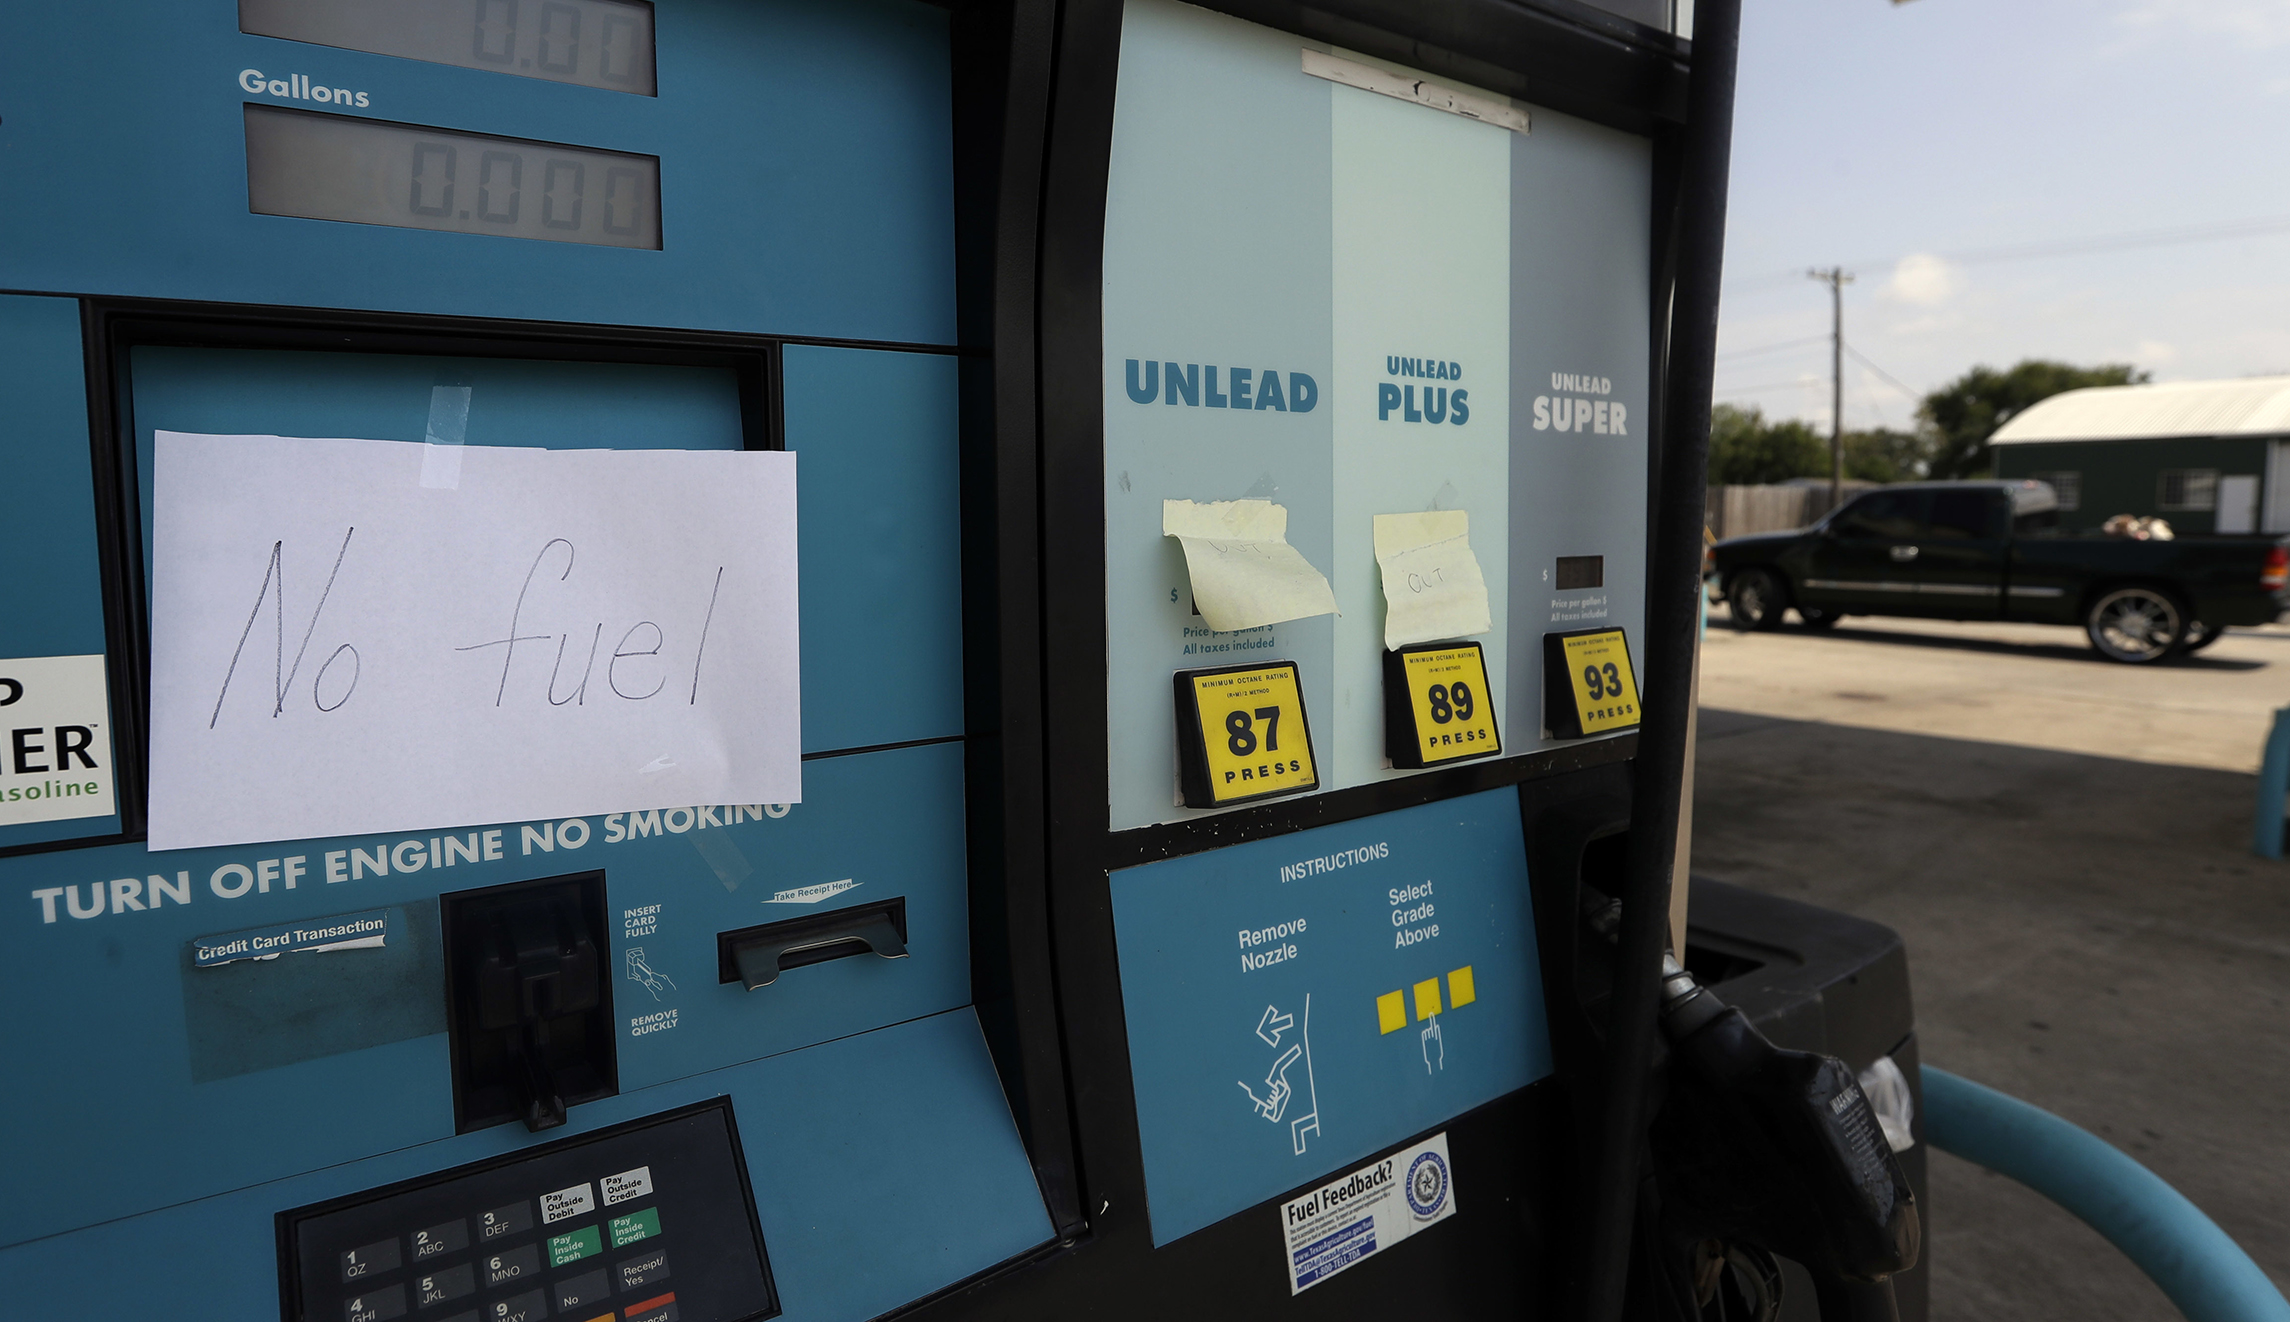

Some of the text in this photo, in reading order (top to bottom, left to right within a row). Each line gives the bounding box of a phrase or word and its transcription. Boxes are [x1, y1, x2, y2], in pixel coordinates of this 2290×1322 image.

[238, 68, 370, 108] Gallons
[409, 141, 644, 236] 0.000
[1387, 355, 1462, 382] UNLEAD
[1125, 358, 1319, 413] UNLEAD
[1551, 372, 1612, 395] UNLEAD
[1378, 382, 1470, 426] PLUS
[1532, 395, 1628, 436] SUPER
[1407, 568, 1444, 594] OUT
[1551, 599, 1567, 609] Price
[1569, 599, 1580, 609] per
[1581, 595, 1601, 609] gallon
[1551, 608, 1608, 622] All taxes included
[210, 526, 723, 730] No fuel
[1183, 626, 1209, 638] Price
[1183, 637, 1275, 655] All taxes included
[1409, 656, 1434, 664] MINIMUM
[1436, 653, 1456, 661] OCTANE
[1202, 672, 1289, 688] MINIMUM OCTANE RATING
[1584, 662, 1623, 701] 93
[1428, 681, 1474, 725] 89
[1587, 704, 1633, 722] PRESS
[1225, 705, 1281, 757] 87
[1429, 728, 1487, 748] PRESS
[0, 725, 99, 775] ER
[1225, 760, 1300, 784] PRESS
[32, 803, 792, 924] TURN OFF ENGINE NO SMOKING
[1280, 841, 1389, 884] INSTRUCTIONS
[774, 881, 852, 902] Take Receipt Here
[1388, 879, 1433, 906] Select
[624, 904, 662, 919] INSERT
[1392, 902, 1435, 928] Grade
[625, 915, 656, 929] CARD
[198, 918, 384, 960] Credit Card Transaction
[625, 924, 658, 939] FULLY
[1238, 917, 1307, 949] Remove
[1395, 923, 1440, 949] Above
[1241, 942, 1298, 973] Nozzle
[631, 1008, 678, 1027] REMOVE
[631, 1018, 679, 1037] QUICKLY
[606, 1176, 623, 1186] Pay
[607, 1179, 642, 1194] Outside
[546, 1193, 563, 1204] Pay
[609, 1189, 638, 1203] Credit
[1288, 1193, 1320, 1226] Fuel
[1322, 1160, 1393, 1210] Feedback?
[547, 1196, 584, 1212] Outside
[483, 1212, 495, 1226] 3
[549, 1207, 575, 1221] Debit
[485, 1221, 510, 1237] DEF
[613, 1217, 631, 1228] Pay
[615, 1222, 643, 1237] Inside
[416, 1231, 429, 1245] 2
[553, 1235, 571, 1247] Pay
[617, 1231, 646, 1246] Credit
[418, 1241, 444, 1257] ABC
[555, 1240, 584, 1256] Inside
[347, 1251, 356, 1265] 1
[490, 1256, 502, 1270] 6
[556, 1251, 581, 1265] Cash
[491, 1265, 520, 1282] MNO
[625, 1275, 644, 1287] Yes
[422, 1277, 434, 1291] 5
[423, 1289, 446, 1304] JKL
[563, 1296, 579, 1307] No
[350, 1298, 363, 1312] 4
[496, 1303, 508, 1317] 9
